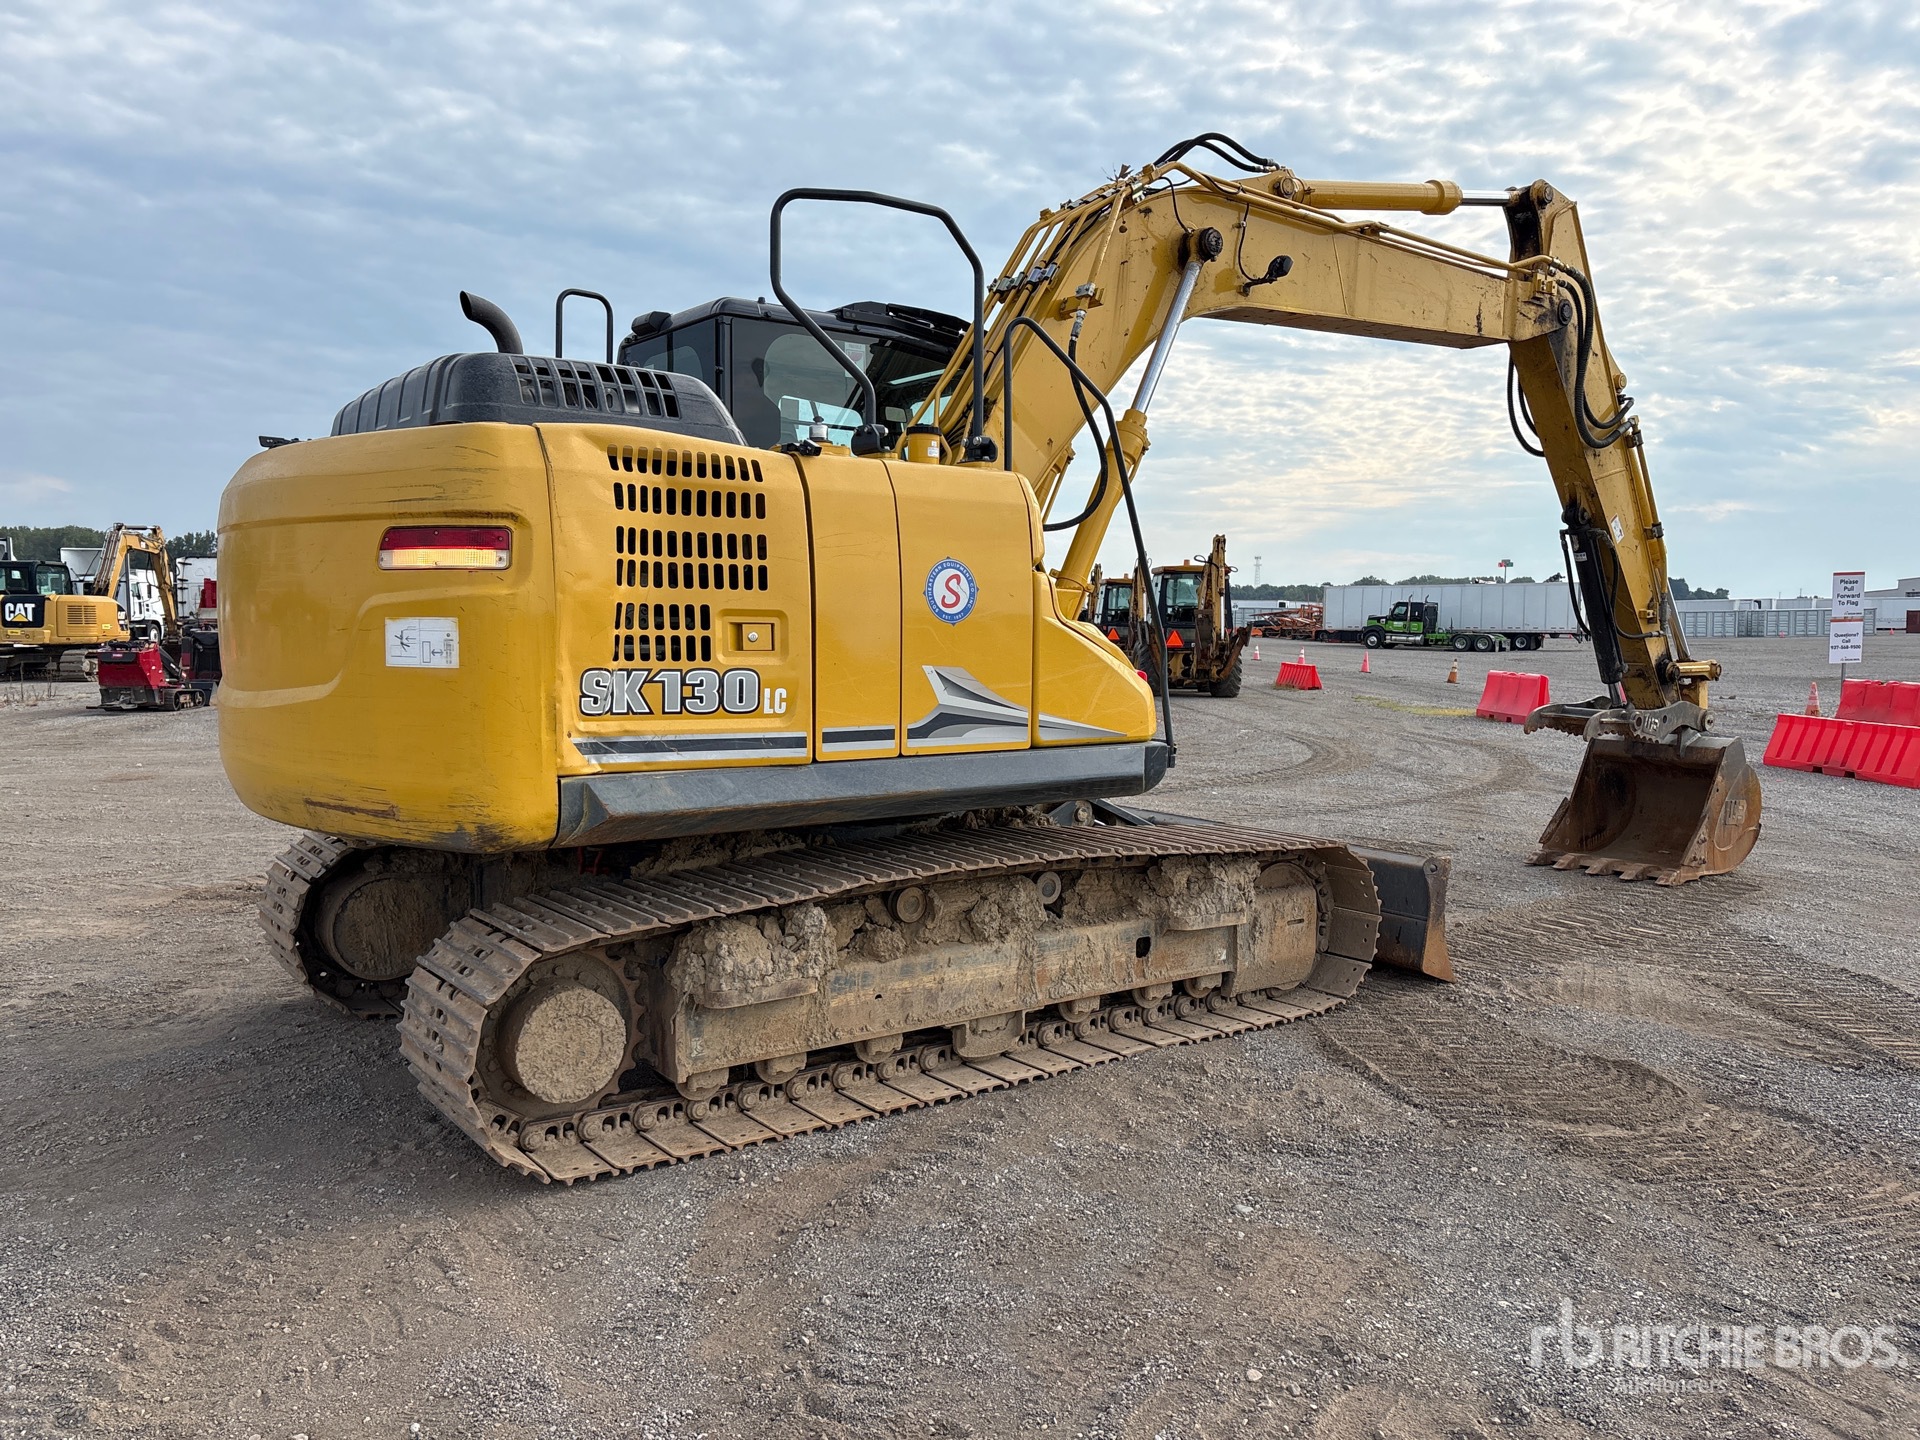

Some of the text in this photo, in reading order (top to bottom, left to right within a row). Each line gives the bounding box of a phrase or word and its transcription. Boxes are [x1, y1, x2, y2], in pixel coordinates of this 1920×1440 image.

[943, 561, 972, 580] EQUIPMENT
[941, 573, 962, 609] S
[4, 602, 36, 622] CAT
[579, 668, 787, 716] SK130 LC
